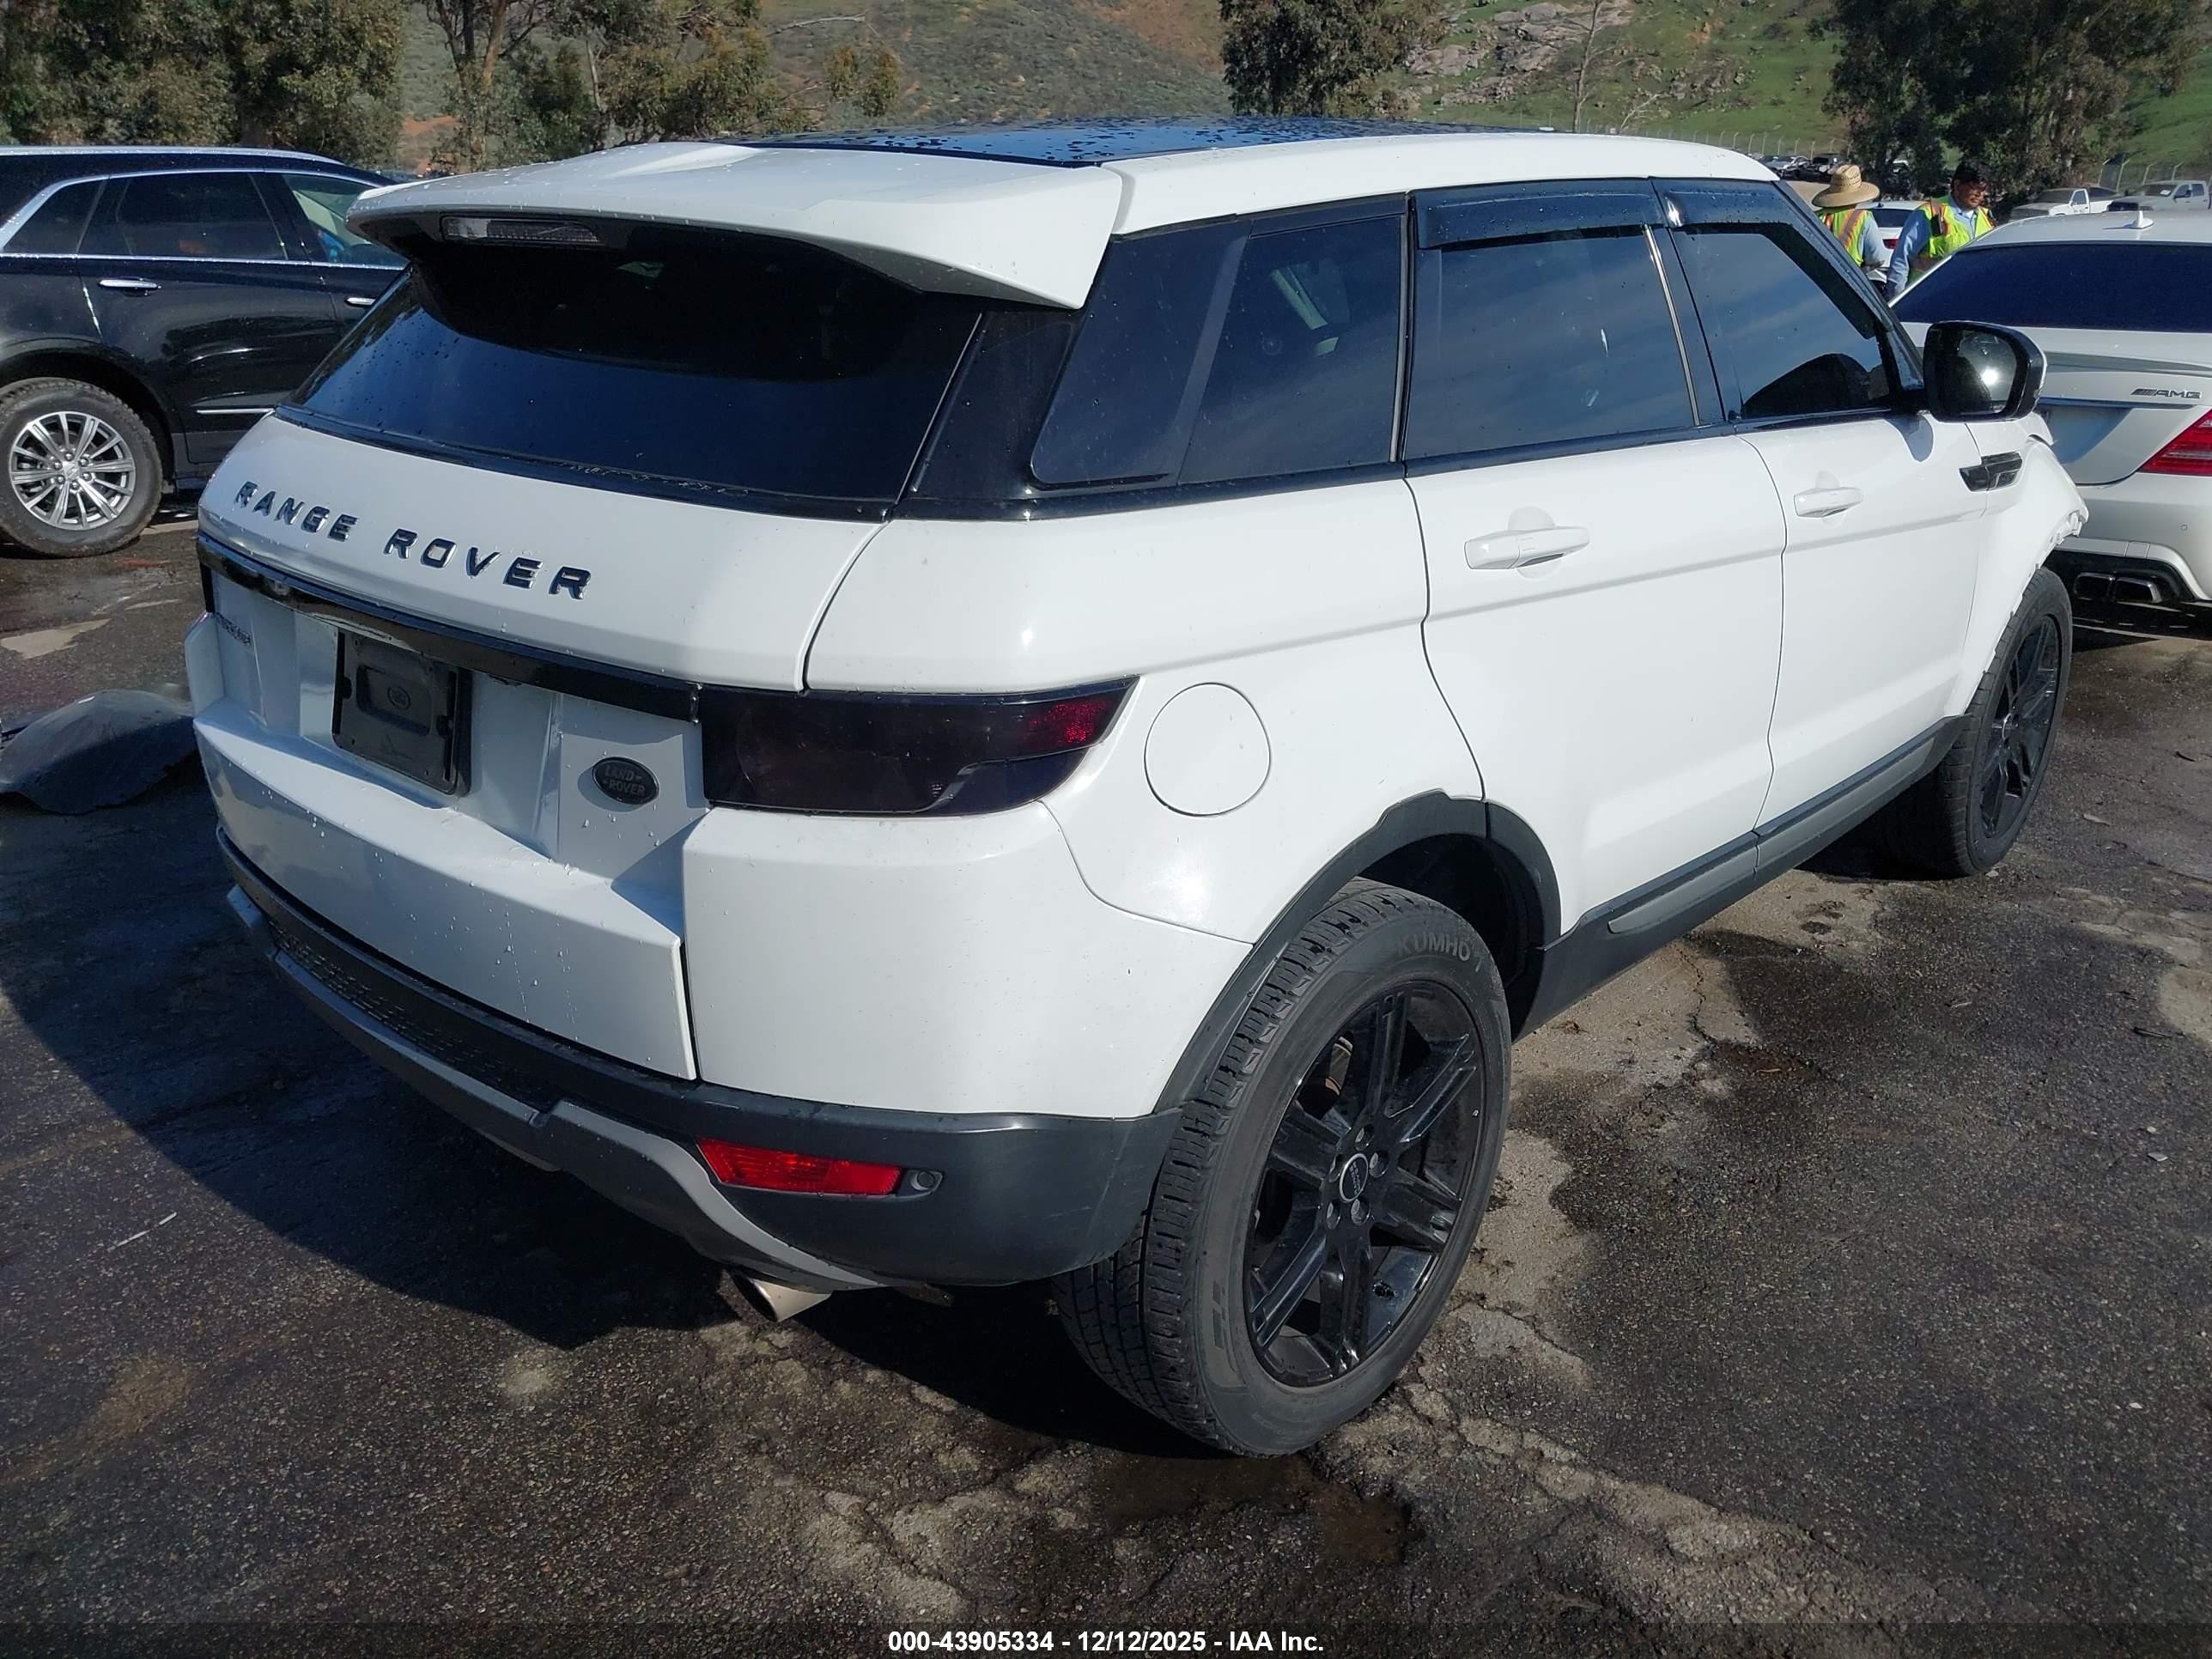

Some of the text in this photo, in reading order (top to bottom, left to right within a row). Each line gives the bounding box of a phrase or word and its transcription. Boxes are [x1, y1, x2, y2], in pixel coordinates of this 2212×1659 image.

[2154, 389, 2201, 399] AMG
[234, 480, 592, 600] RANGE ROVER
[608, 778, 646, 797] ROVER
[1397, 931, 1471, 961] KUMHO
